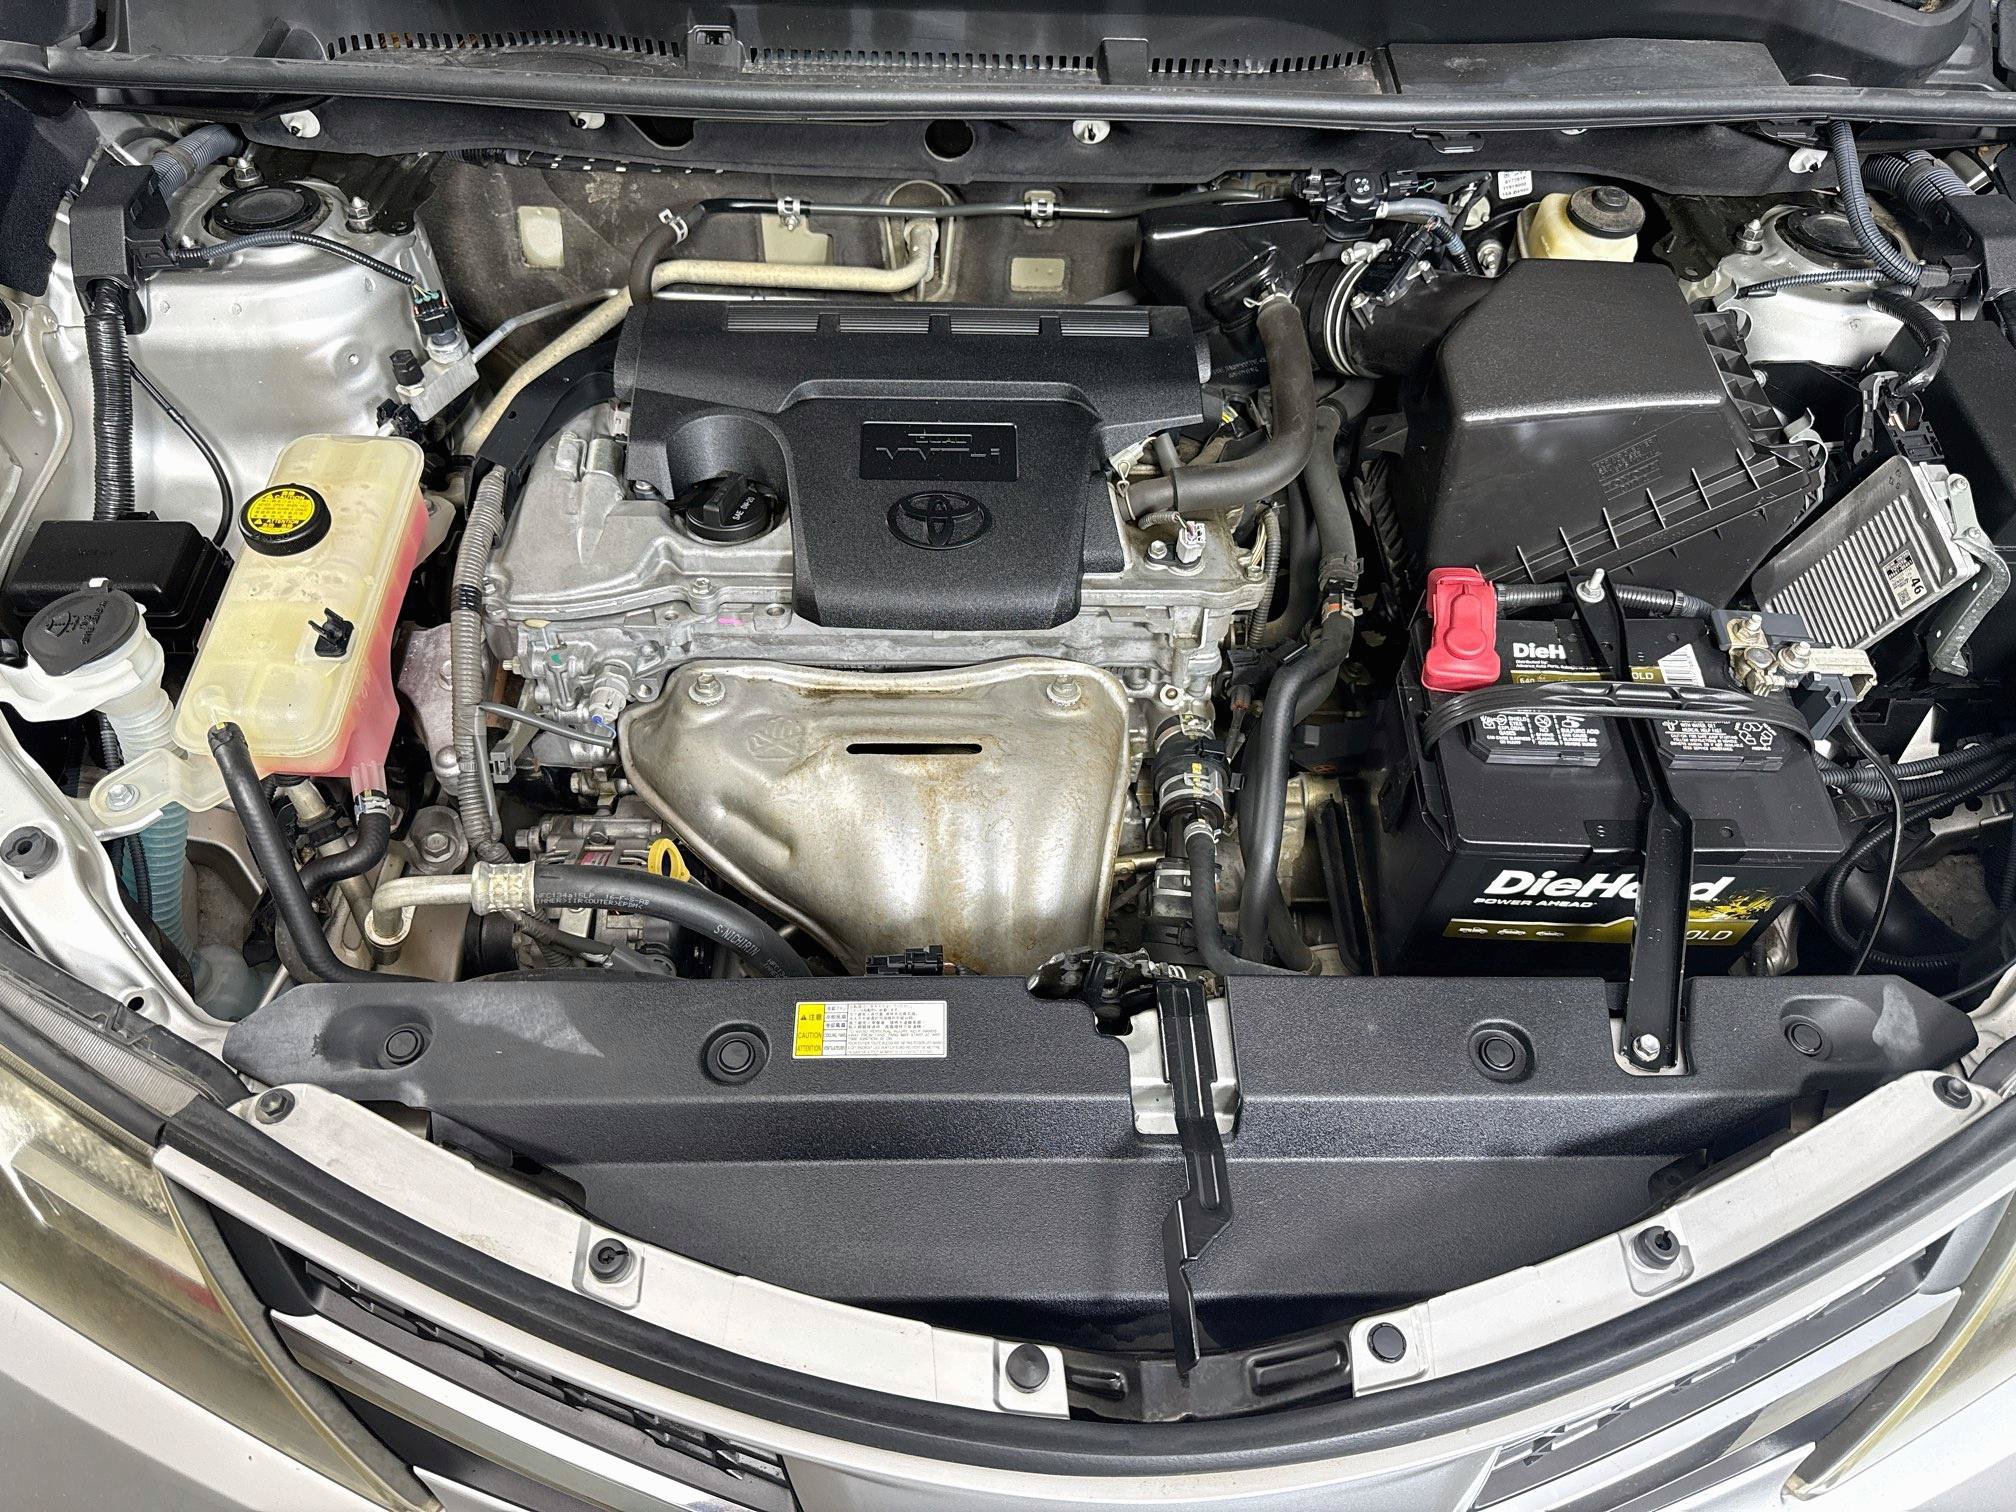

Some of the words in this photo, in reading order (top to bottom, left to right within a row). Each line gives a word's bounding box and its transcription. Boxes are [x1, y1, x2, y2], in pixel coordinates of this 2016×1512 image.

[1911, 578, 1925, 595] 46
[1483, 869, 1735, 901] DieHad
[1473, 898, 1533, 906] POWER
[798, 1031, 822, 1039] CAUTION
[796, 1044, 822, 1052] ATTENTION
